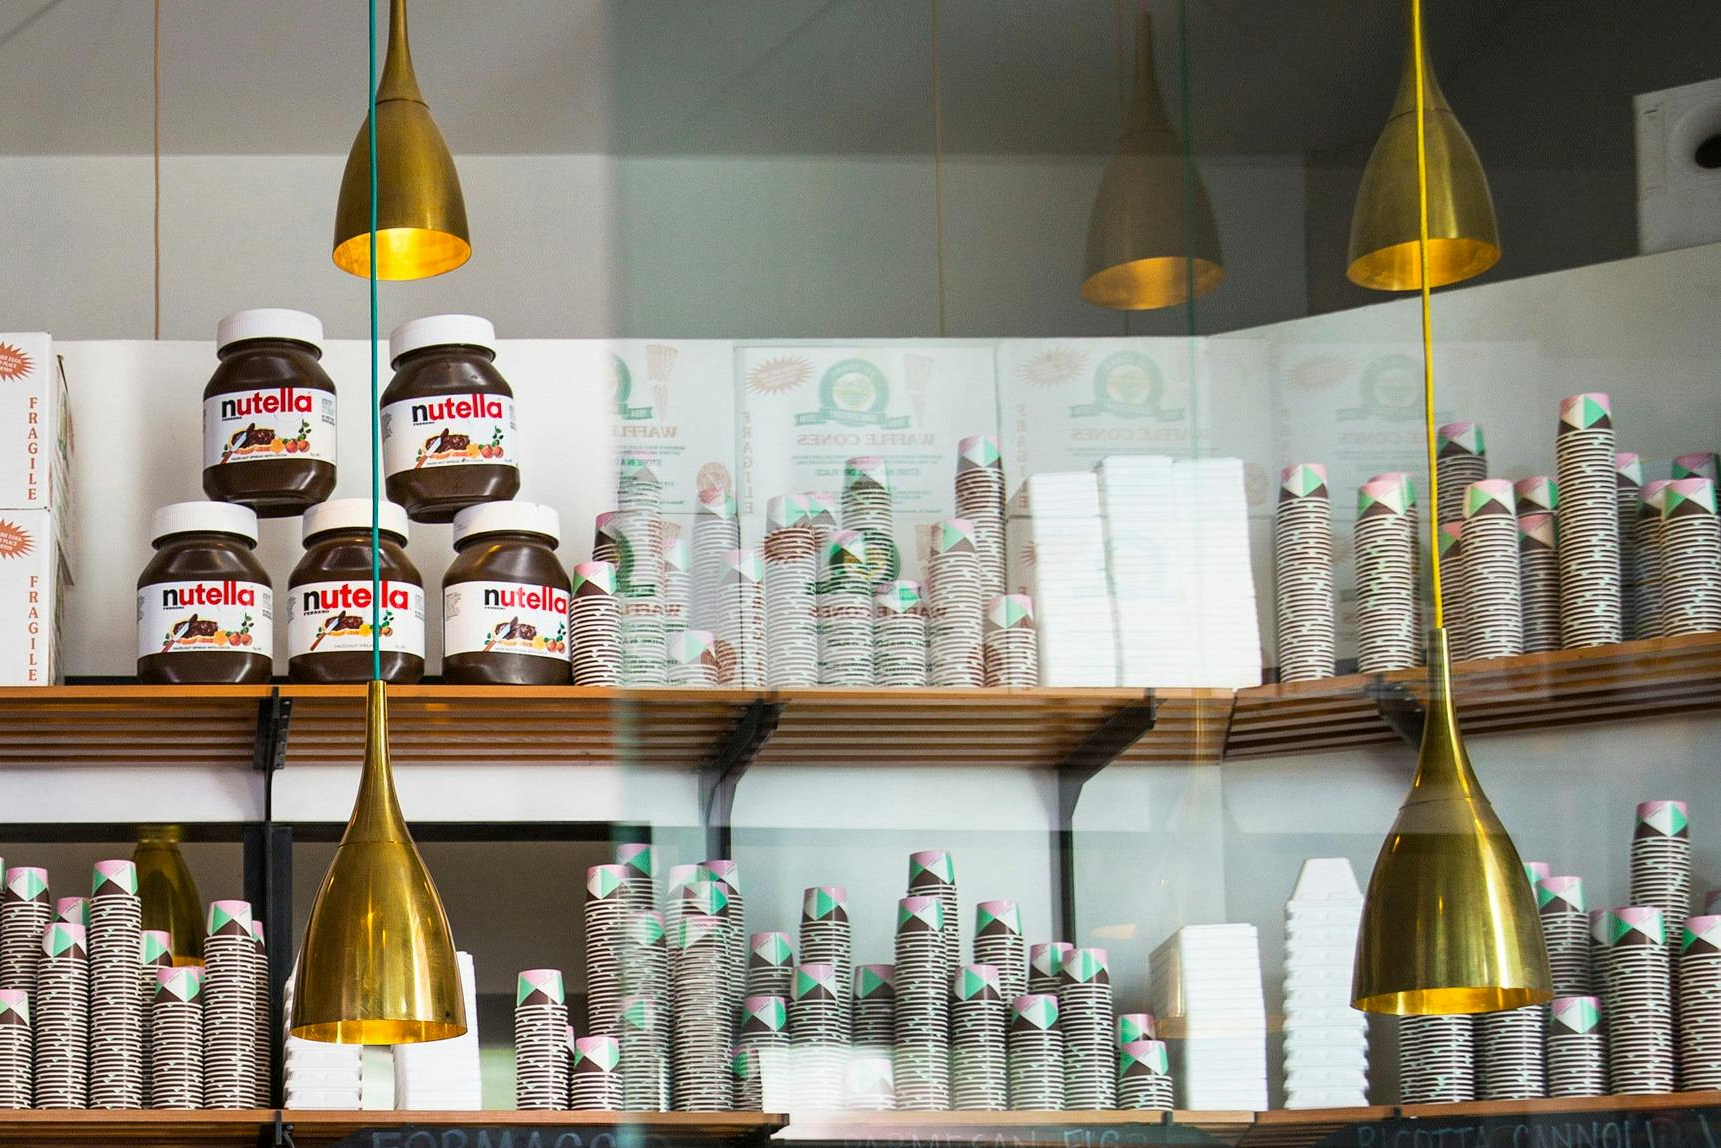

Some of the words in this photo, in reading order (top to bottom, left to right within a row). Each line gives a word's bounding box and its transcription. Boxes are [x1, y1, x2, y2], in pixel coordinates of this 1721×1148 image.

[221, 388, 312, 418] nutella
[412, 393, 503, 422] nutella
[28, 398, 38, 500] FRAGILE
[162, 580, 254, 608] nutella
[303, 580, 409, 612] nutela
[484, 586, 567, 615] nutella
[29, 576, 38, 681] FRAGILE
